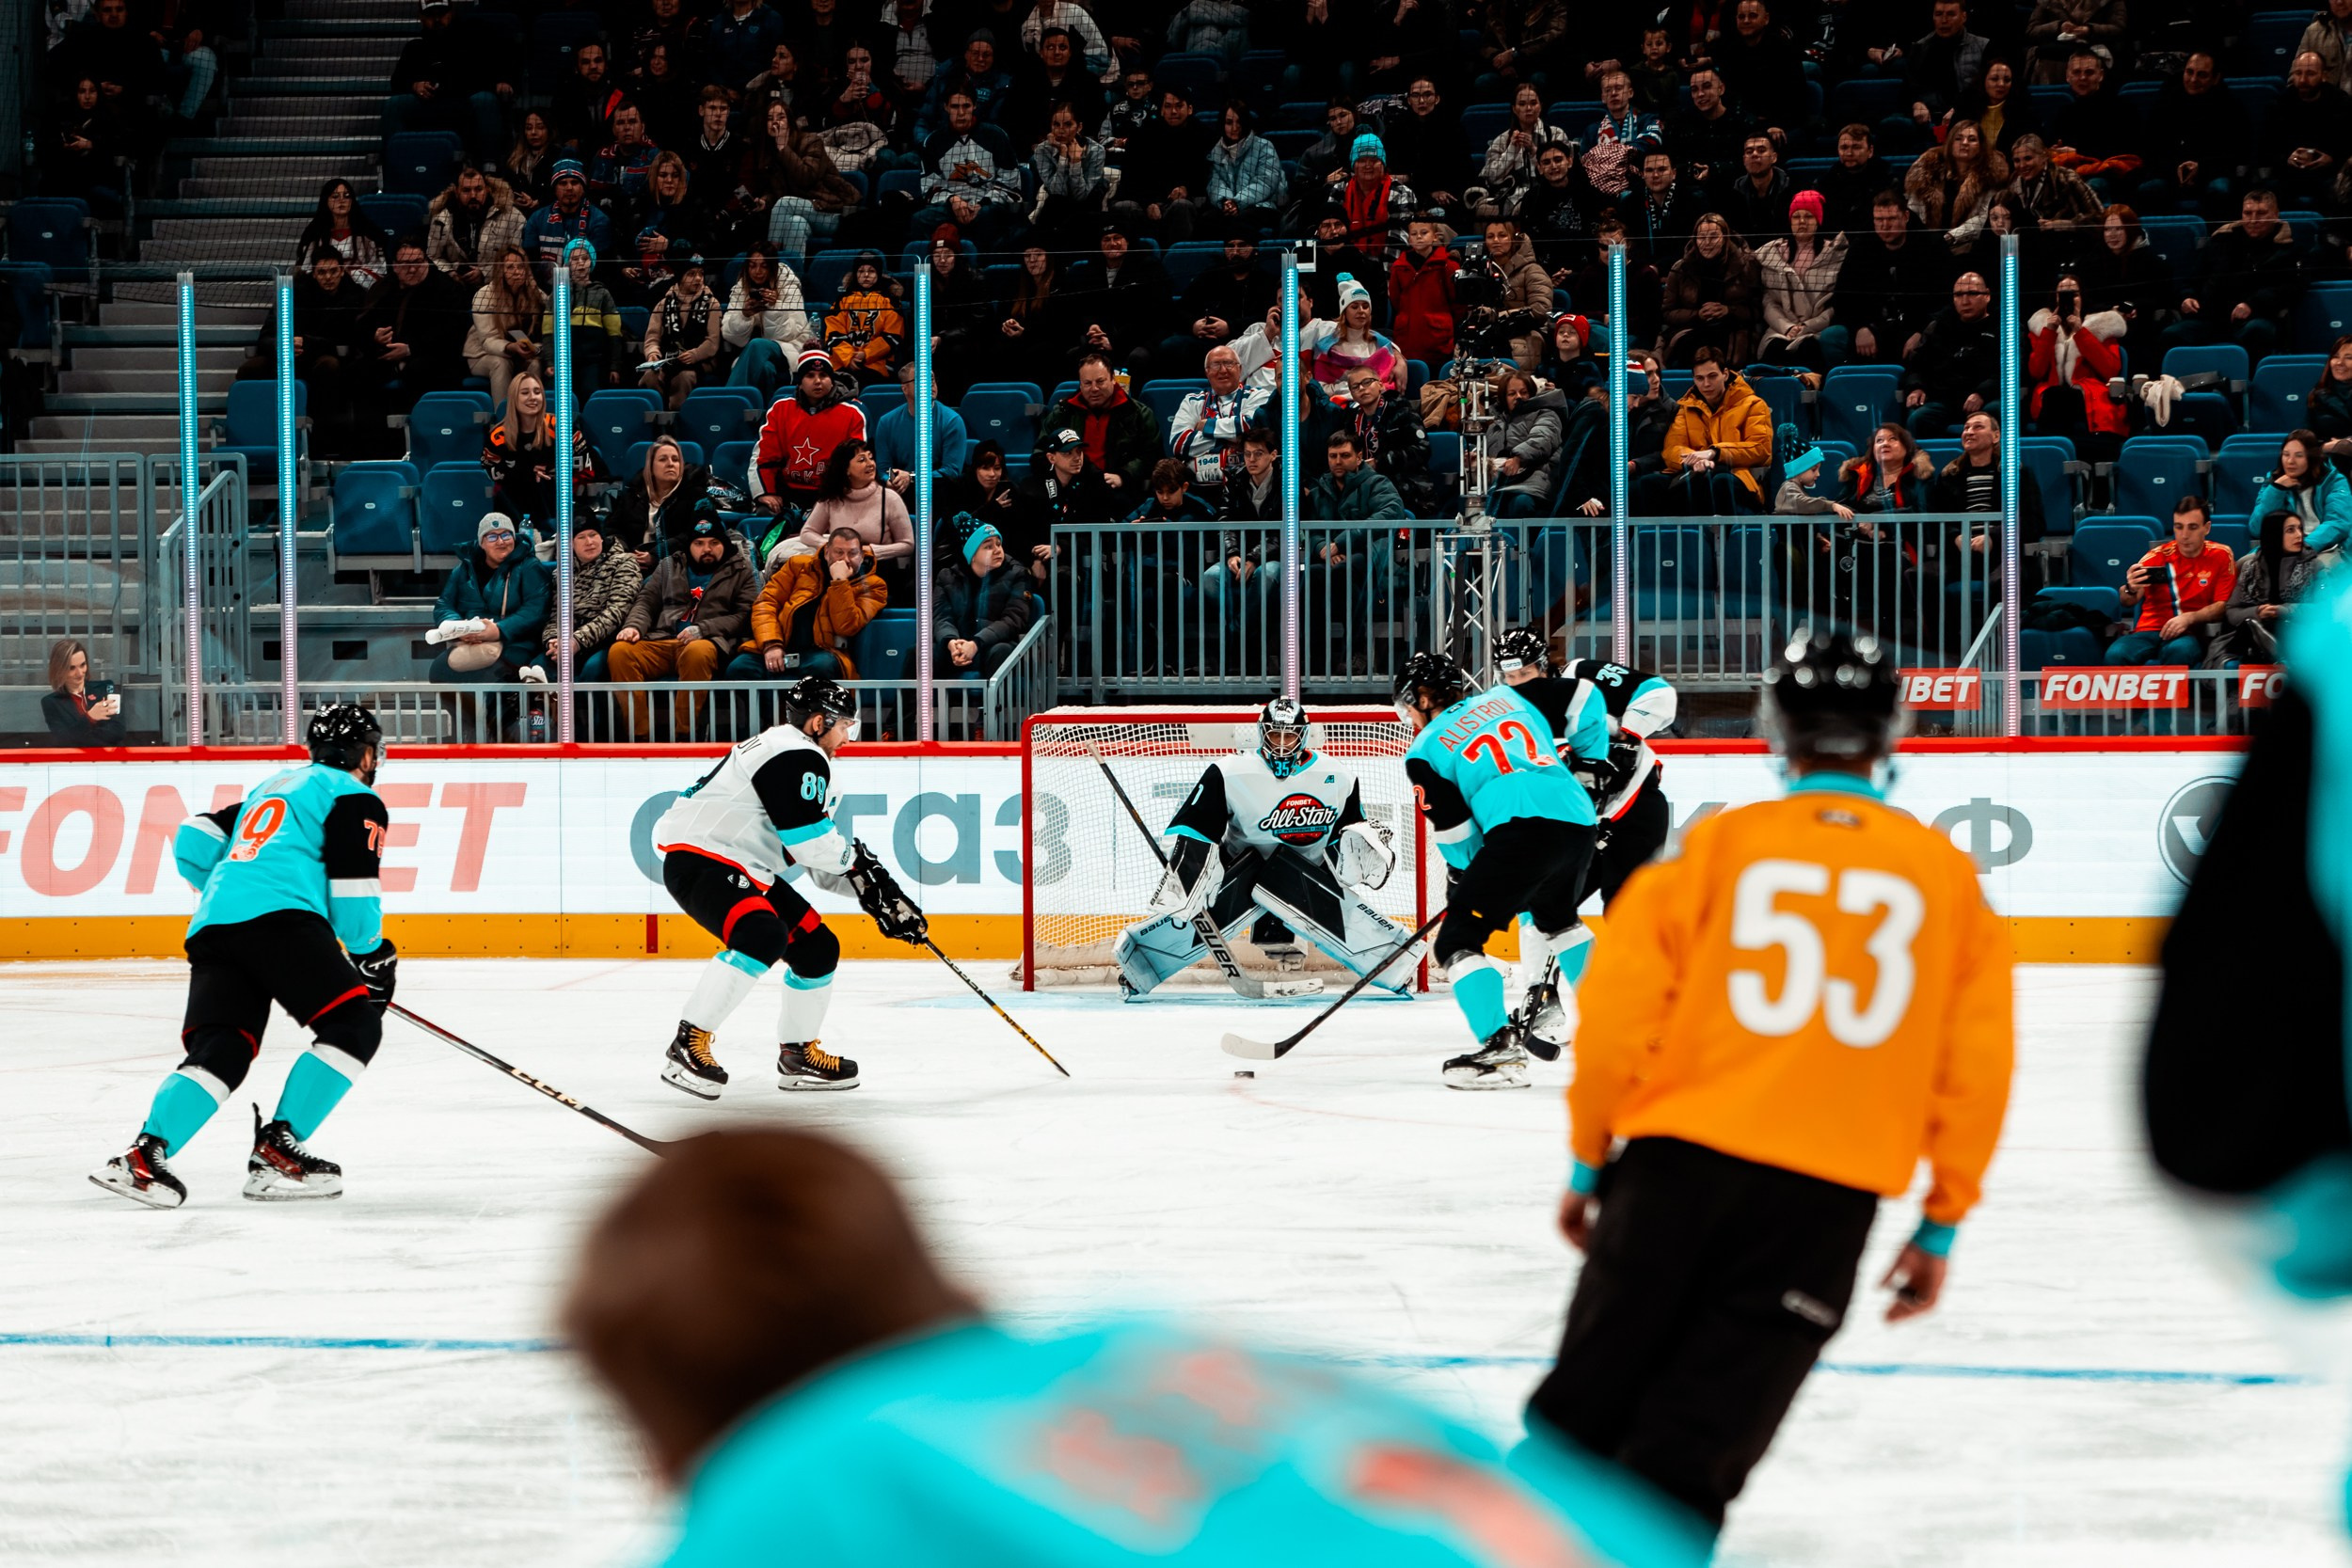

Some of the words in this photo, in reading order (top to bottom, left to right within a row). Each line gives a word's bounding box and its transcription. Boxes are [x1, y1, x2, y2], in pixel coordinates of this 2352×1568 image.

[1198, 457, 1218, 466] 1946
[2042, 673, 2185, 701] FONBET
[1438, 698, 1515, 752] ALISTROV
[1461, 720, 1555, 775] 72
[1275, 761, 1289, 777] 35
[801, 771, 827, 804] 89
[1260, 805, 1337, 830] All-Star
[364, 818, 386, 859] 79
[1139, 916, 1172, 936] BAUE
[1356, 903, 1395, 931] BAUER
[1727, 858, 1926, 1049] 53
[511, 1068, 585, 1112] CCM
